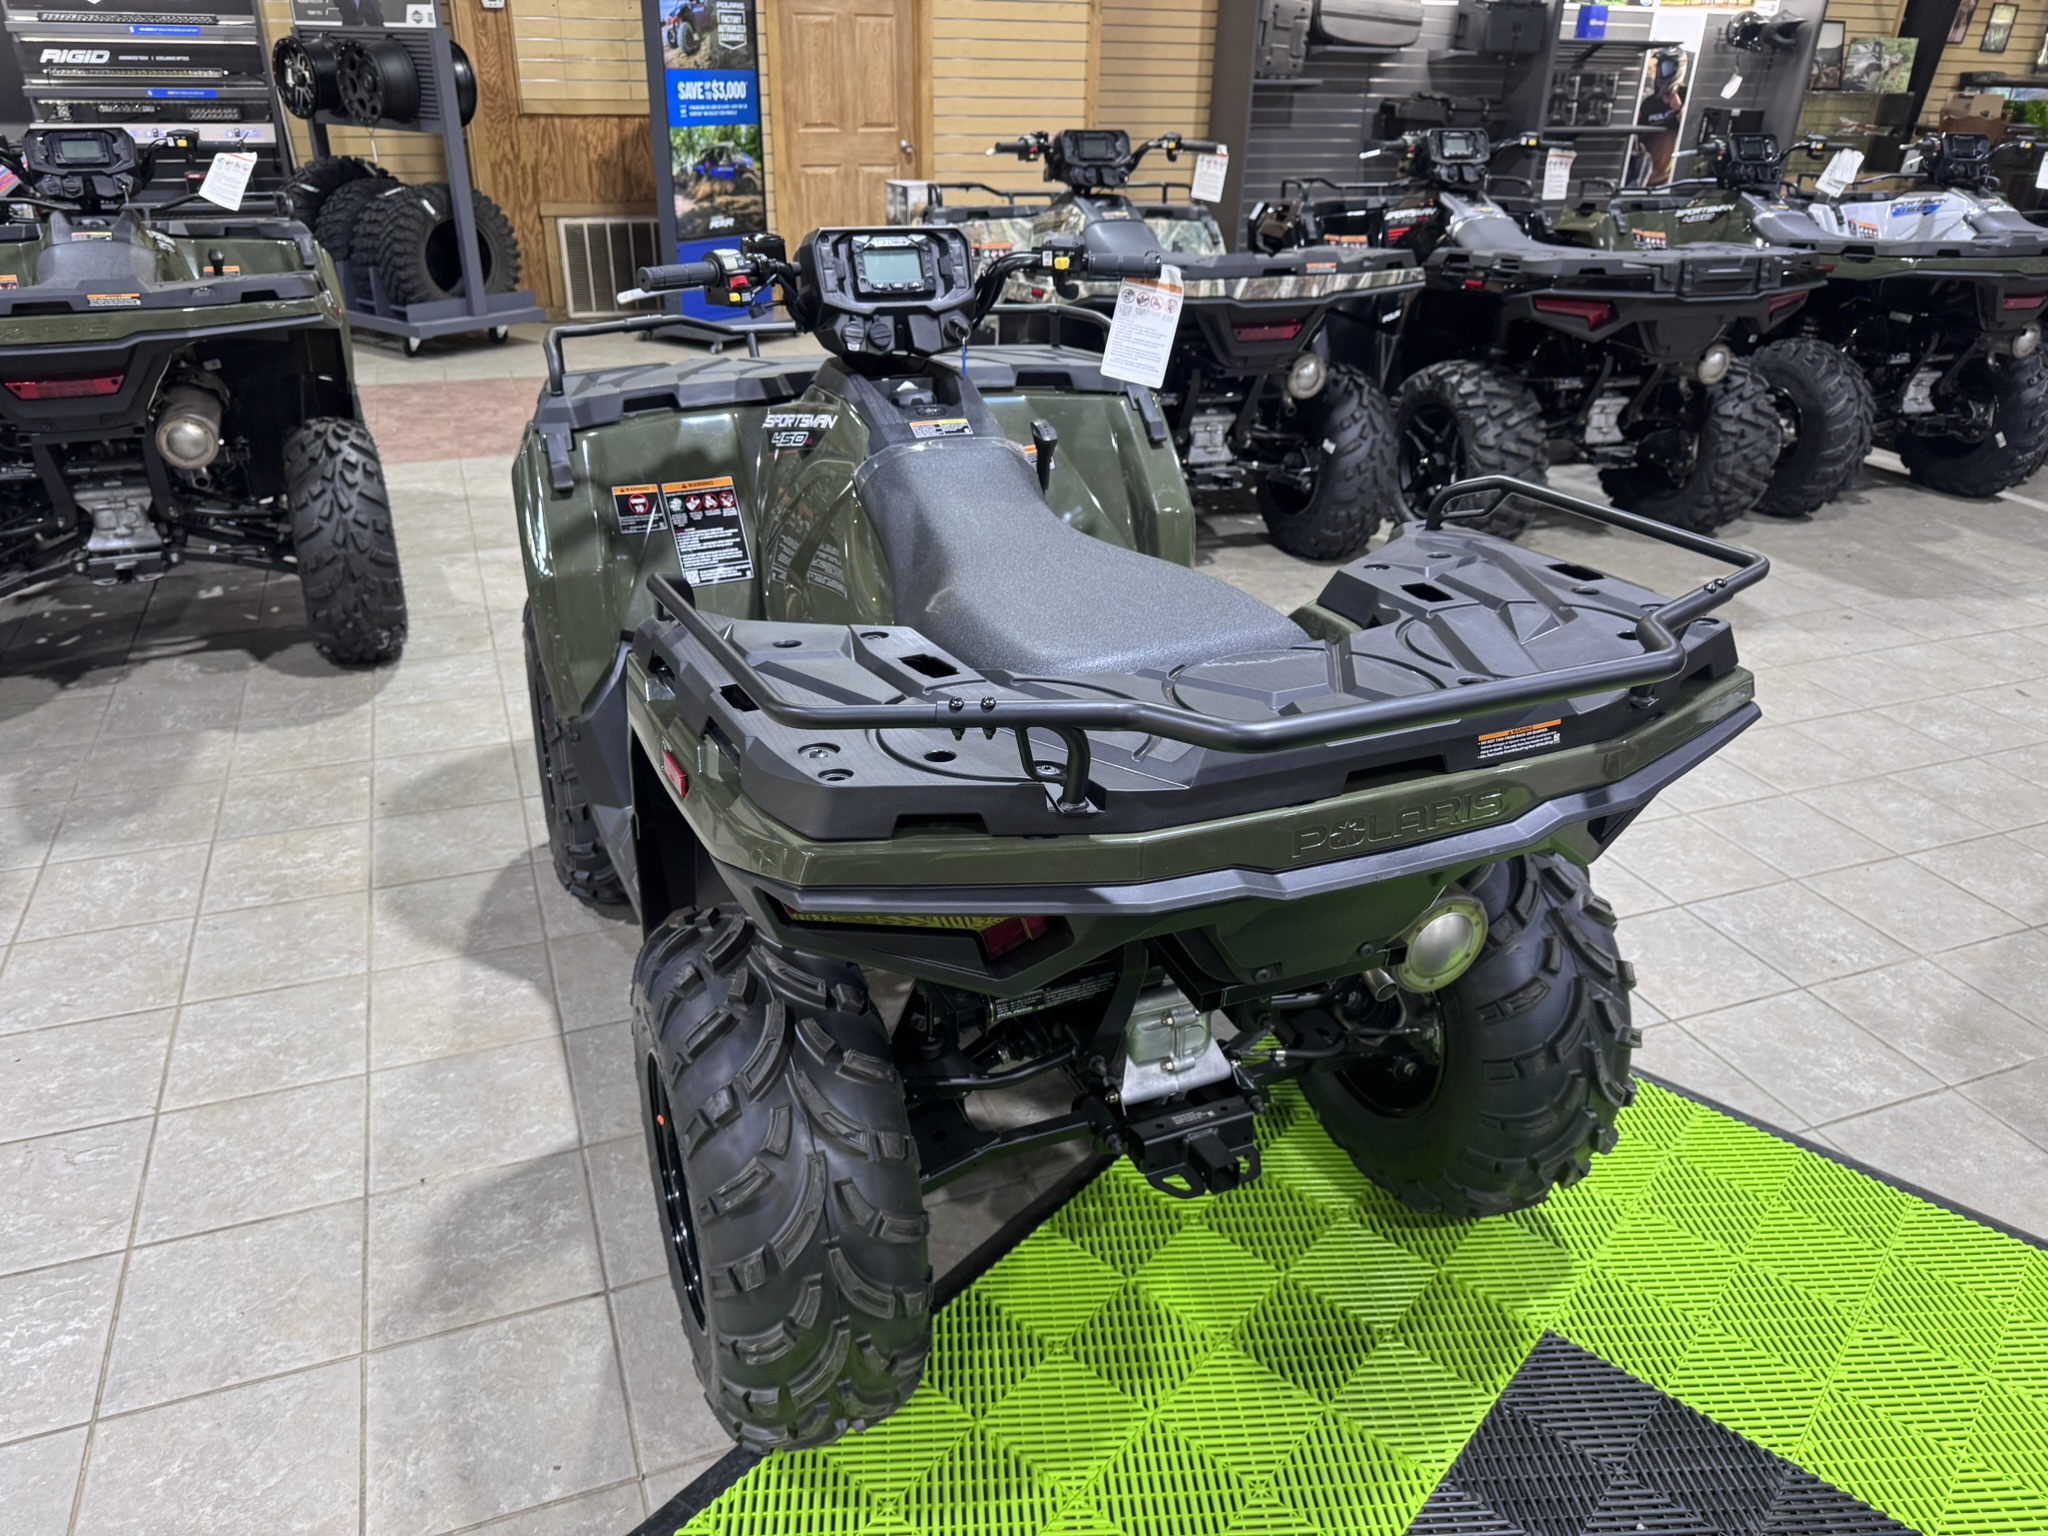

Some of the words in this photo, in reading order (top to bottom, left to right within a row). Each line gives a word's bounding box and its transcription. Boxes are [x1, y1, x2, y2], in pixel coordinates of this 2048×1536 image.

[716, 1, 745, 9] POLARIS
[40, 49, 110, 64] RIGID
[677, 81, 704, 100] SAVE
[762, 414, 838, 430] SPORTSMAN
[771, 431, 809, 447] 450
[688, 480, 714, 488] WARNING
[1291, 790, 1504, 859] POLARIS
